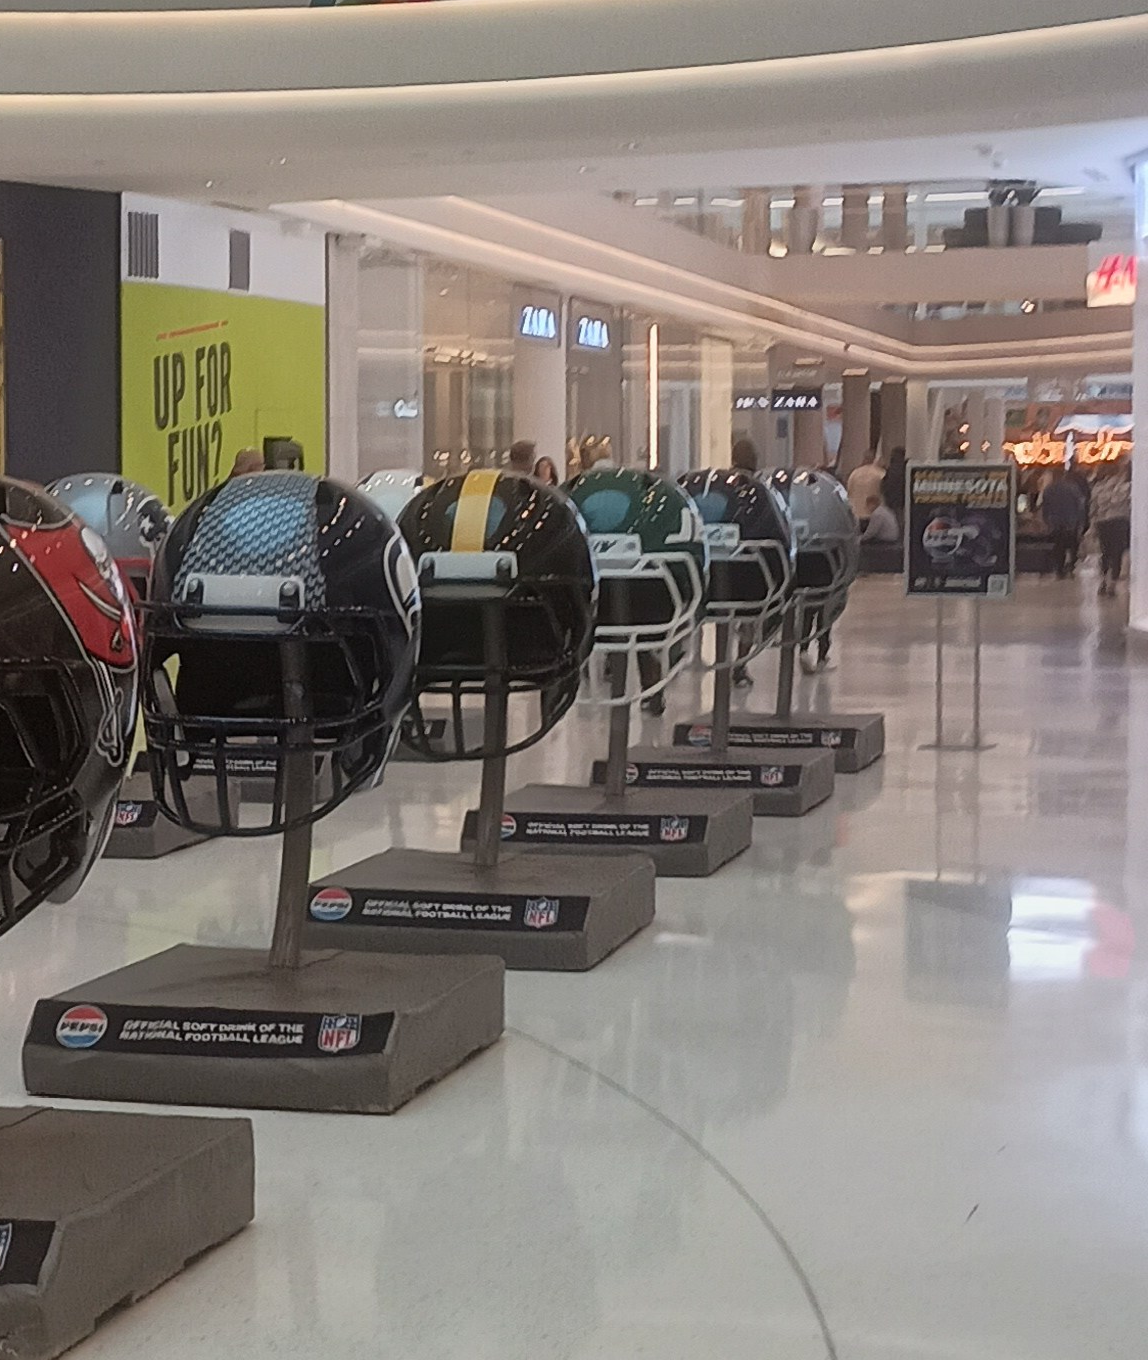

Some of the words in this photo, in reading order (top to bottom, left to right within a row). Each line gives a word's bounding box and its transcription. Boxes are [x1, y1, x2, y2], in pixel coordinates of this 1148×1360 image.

[154, 352, 186, 431] UP
[196, 342, 232, 422] FOR
[168, 419, 223, 507] FUN?
[528, 911, 555, 927] NFL
[60, 1021, 103, 1033] PEPSI
[123, 1019, 180, 1031] OFFICIAL
[182, 1021, 218, 1032] SOFT
[219, 1022, 256, 1033] DRINK
[259, 1023, 278, 1033] OF
[279, 1023, 304, 1034] THE
[119, 1030, 182, 1042] NATIONAL
[184, 1032, 250, 1043] FOOTBALL
[253, 1034, 304, 1045] LEAGUE
[322, 1029, 353, 1048] NFL
